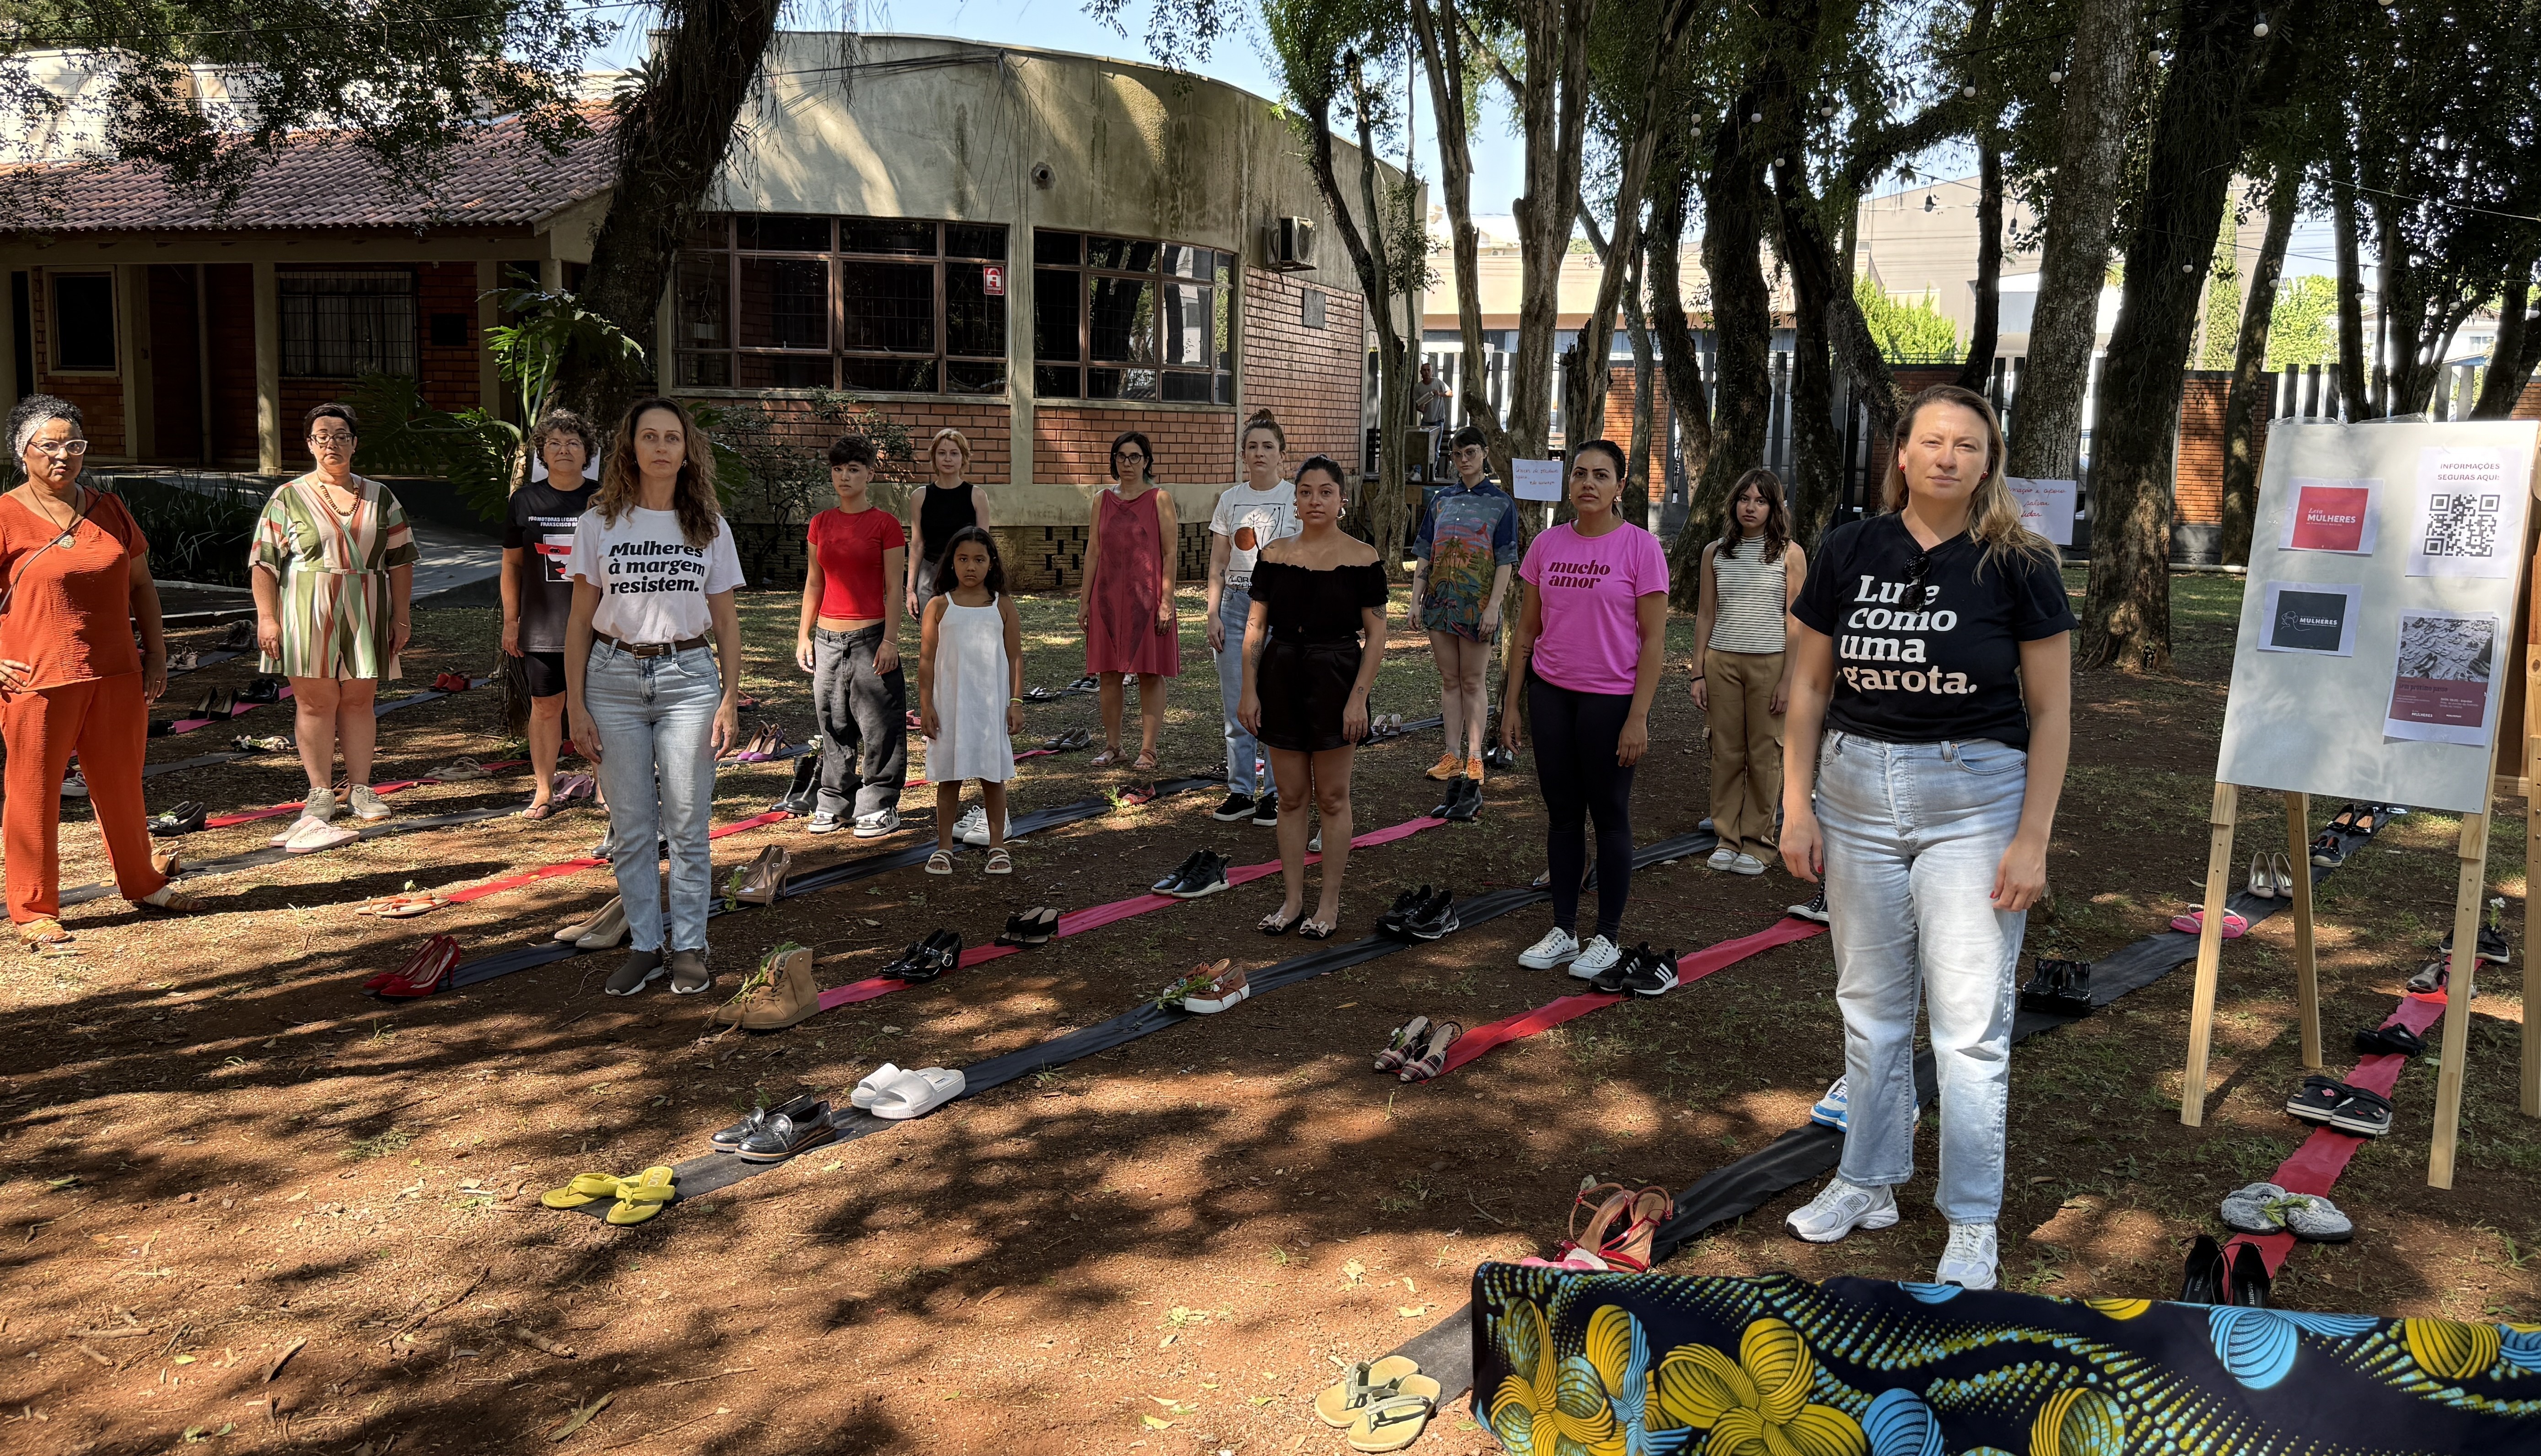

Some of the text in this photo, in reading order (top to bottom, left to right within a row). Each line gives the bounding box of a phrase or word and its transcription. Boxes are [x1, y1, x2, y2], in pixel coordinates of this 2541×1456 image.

[2307, 514, 2356, 523] MULHERES
[608, 541, 704, 558] Mulheres
[608, 558, 705, 577] à margem
[1548, 559, 1611, 575] mucho
[610, 576, 699, 594] resistem.
[1548, 575, 1601, 589] amor
[1854, 575, 1940, 605] Lue
[1848, 607, 1957, 631] como
[1840, 635, 1926, 663] uma
[1843, 666, 1977, 694] garota.
